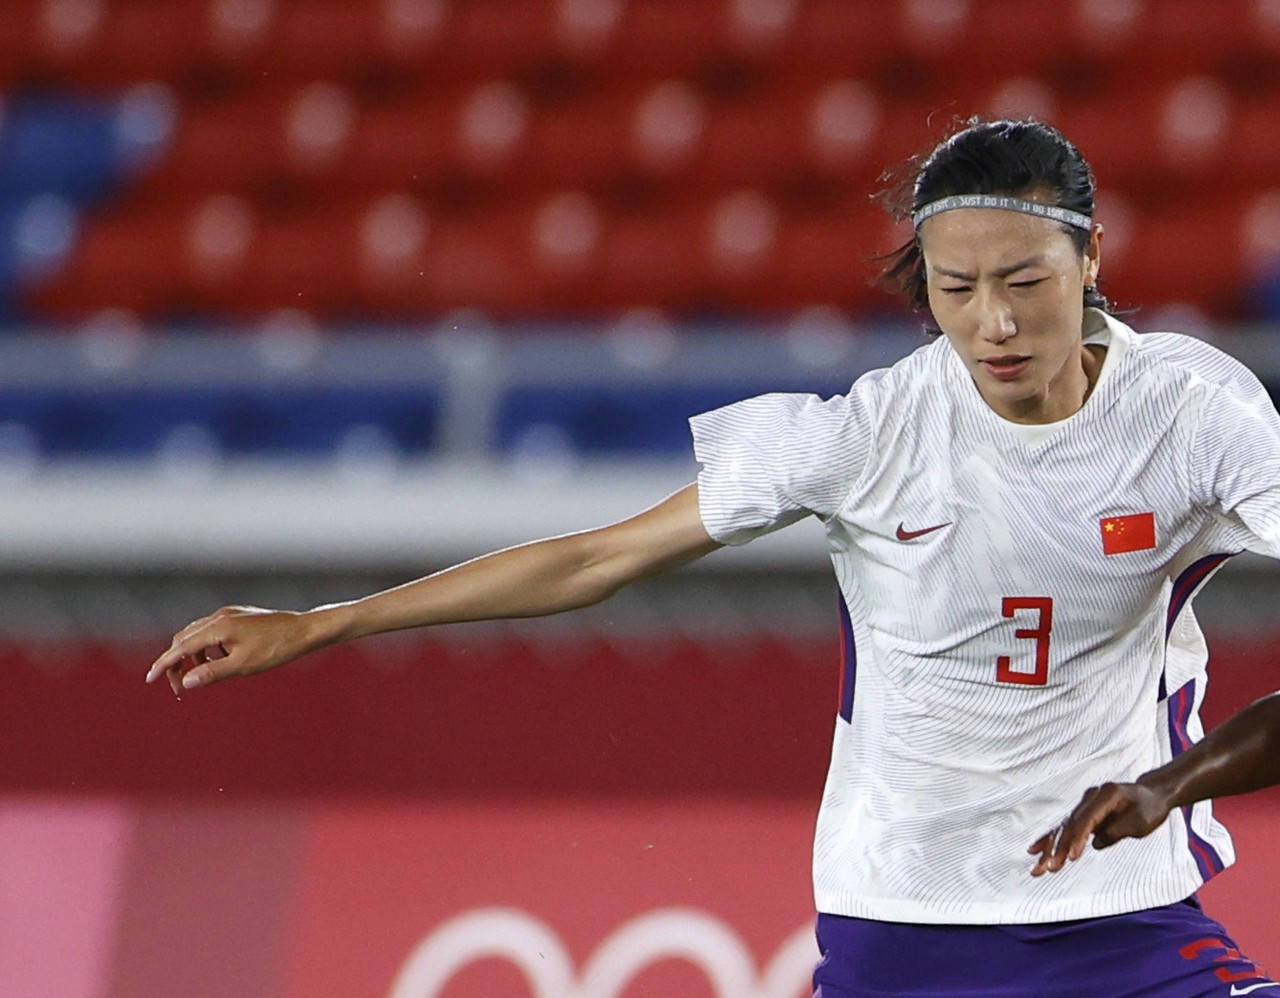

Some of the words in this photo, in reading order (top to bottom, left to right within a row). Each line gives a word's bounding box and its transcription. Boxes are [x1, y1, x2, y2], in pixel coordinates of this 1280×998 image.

[959, 196, 981, 206] JUST
[984, 197, 997, 206] DO
[999, 198, 1009, 207] IT
[996, 596, 1053, 685] 3
